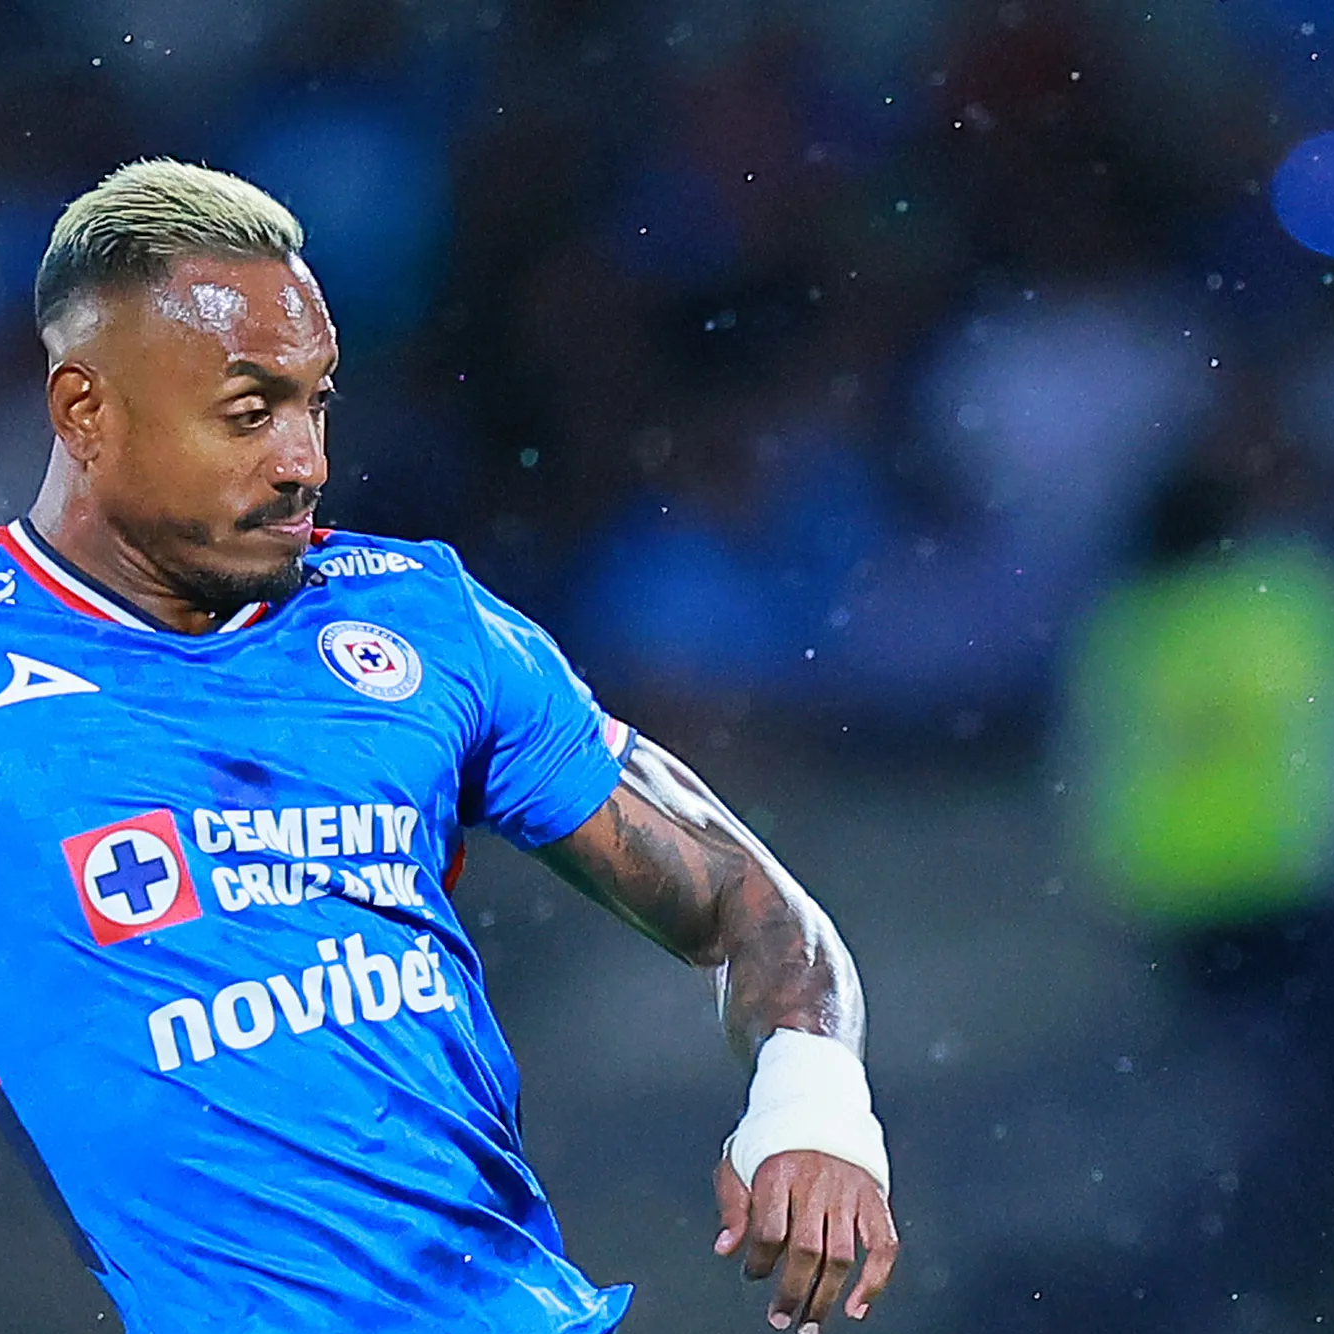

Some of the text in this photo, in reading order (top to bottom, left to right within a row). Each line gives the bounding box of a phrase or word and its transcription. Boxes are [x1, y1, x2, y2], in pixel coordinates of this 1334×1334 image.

[309, 548, 424, 583] ovibet
[193, 804, 419, 858] CEMENTO
[211, 862, 332, 912] CRUZ
[148, 932, 456, 1073] novibet
